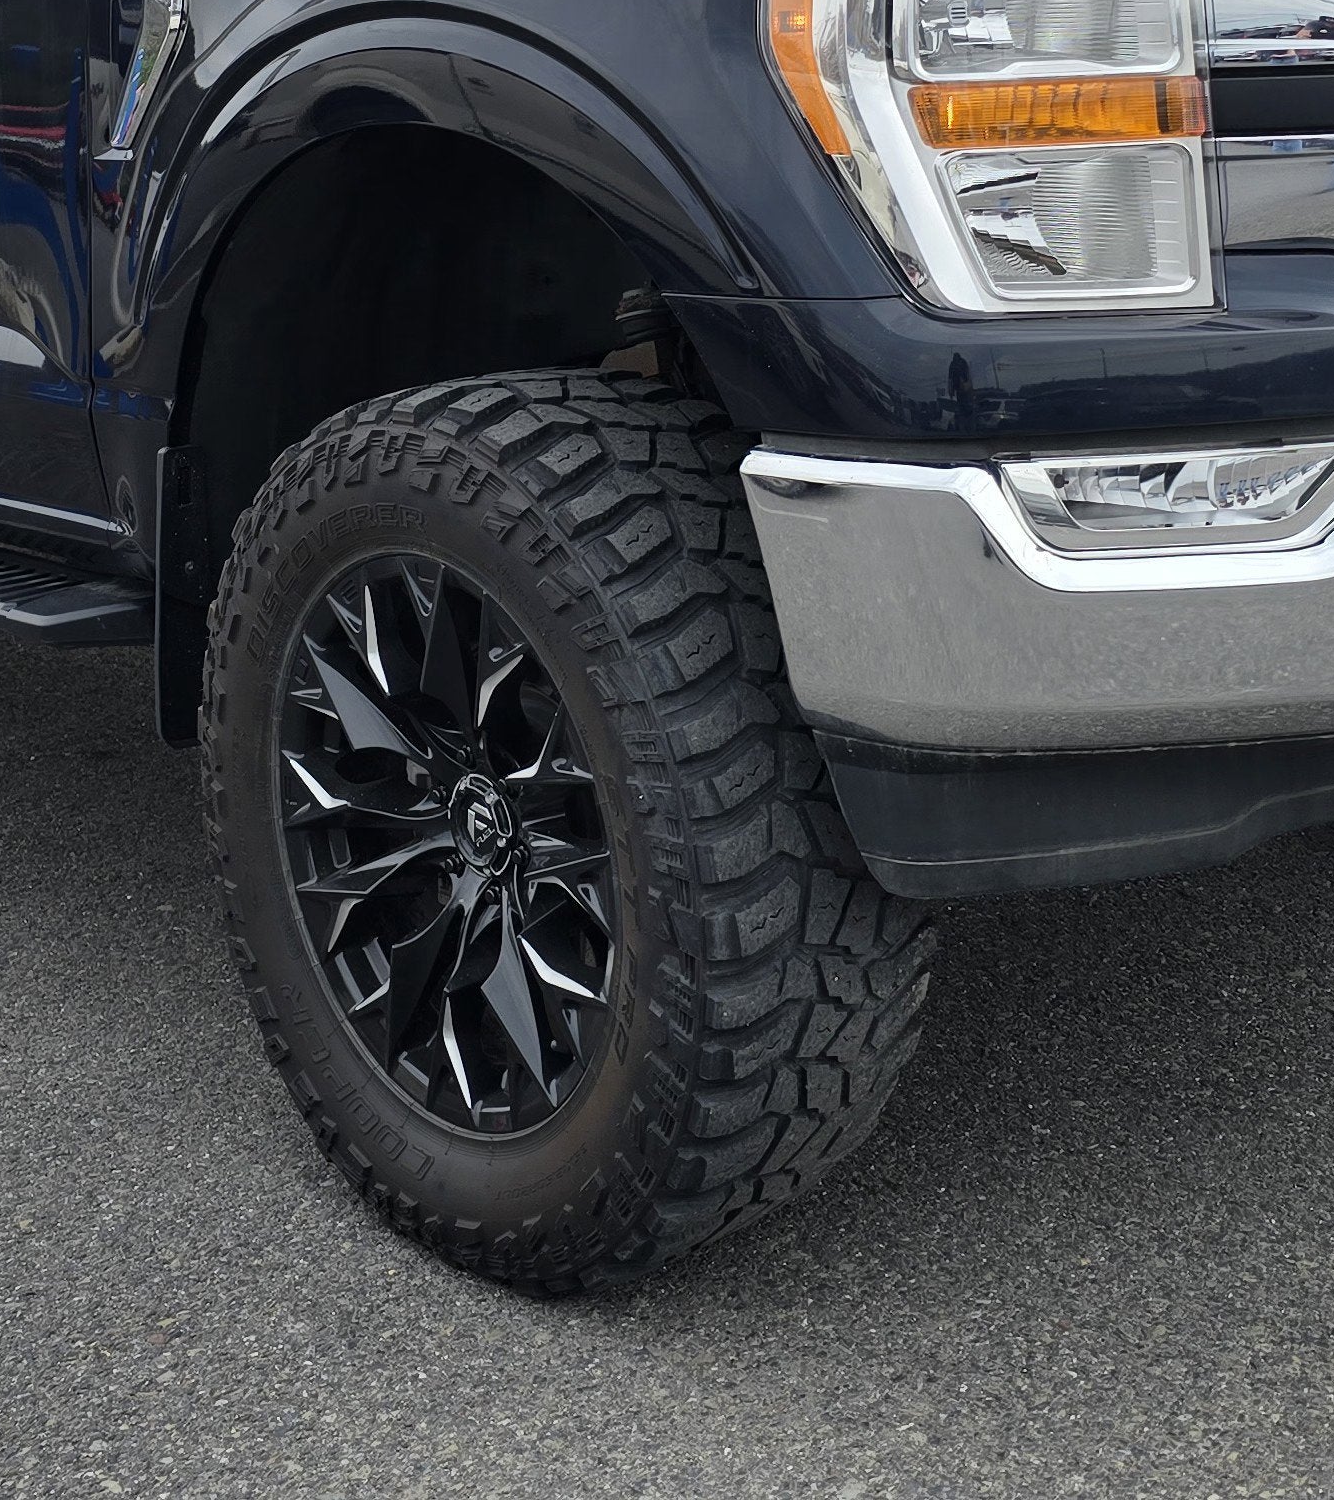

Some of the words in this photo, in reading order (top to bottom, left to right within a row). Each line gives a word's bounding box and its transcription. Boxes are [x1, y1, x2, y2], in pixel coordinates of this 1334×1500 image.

[246, 502, 427, 668] DISCOVERER
[475, 827, 496, 848] FUEL
[278, 983, 436, 1181] COOPER
